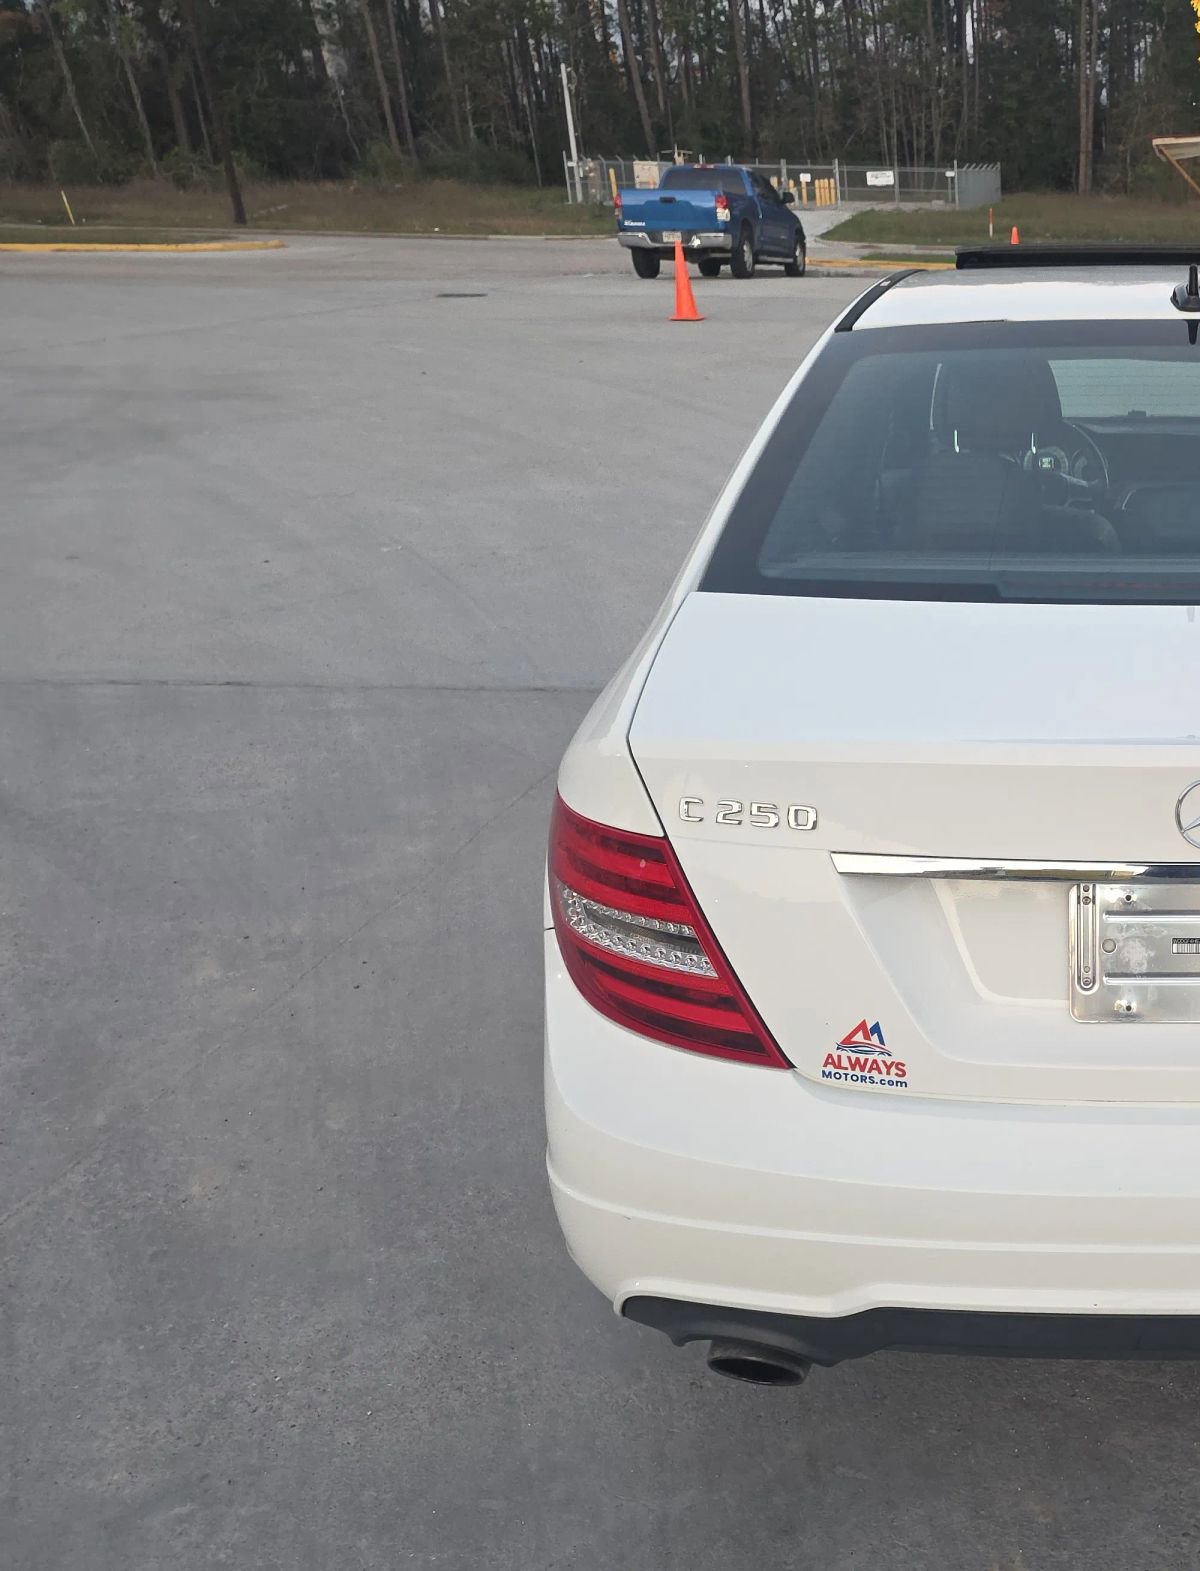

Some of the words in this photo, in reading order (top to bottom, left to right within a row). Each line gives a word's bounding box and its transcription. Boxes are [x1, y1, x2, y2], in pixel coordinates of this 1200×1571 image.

[678, 796, 704, 822] C
[715, 798, 818, 831] 250
[822, 1053, 907, 1078] ALWAYS
[821, 1069, 908, 1088] MOTORS.com
